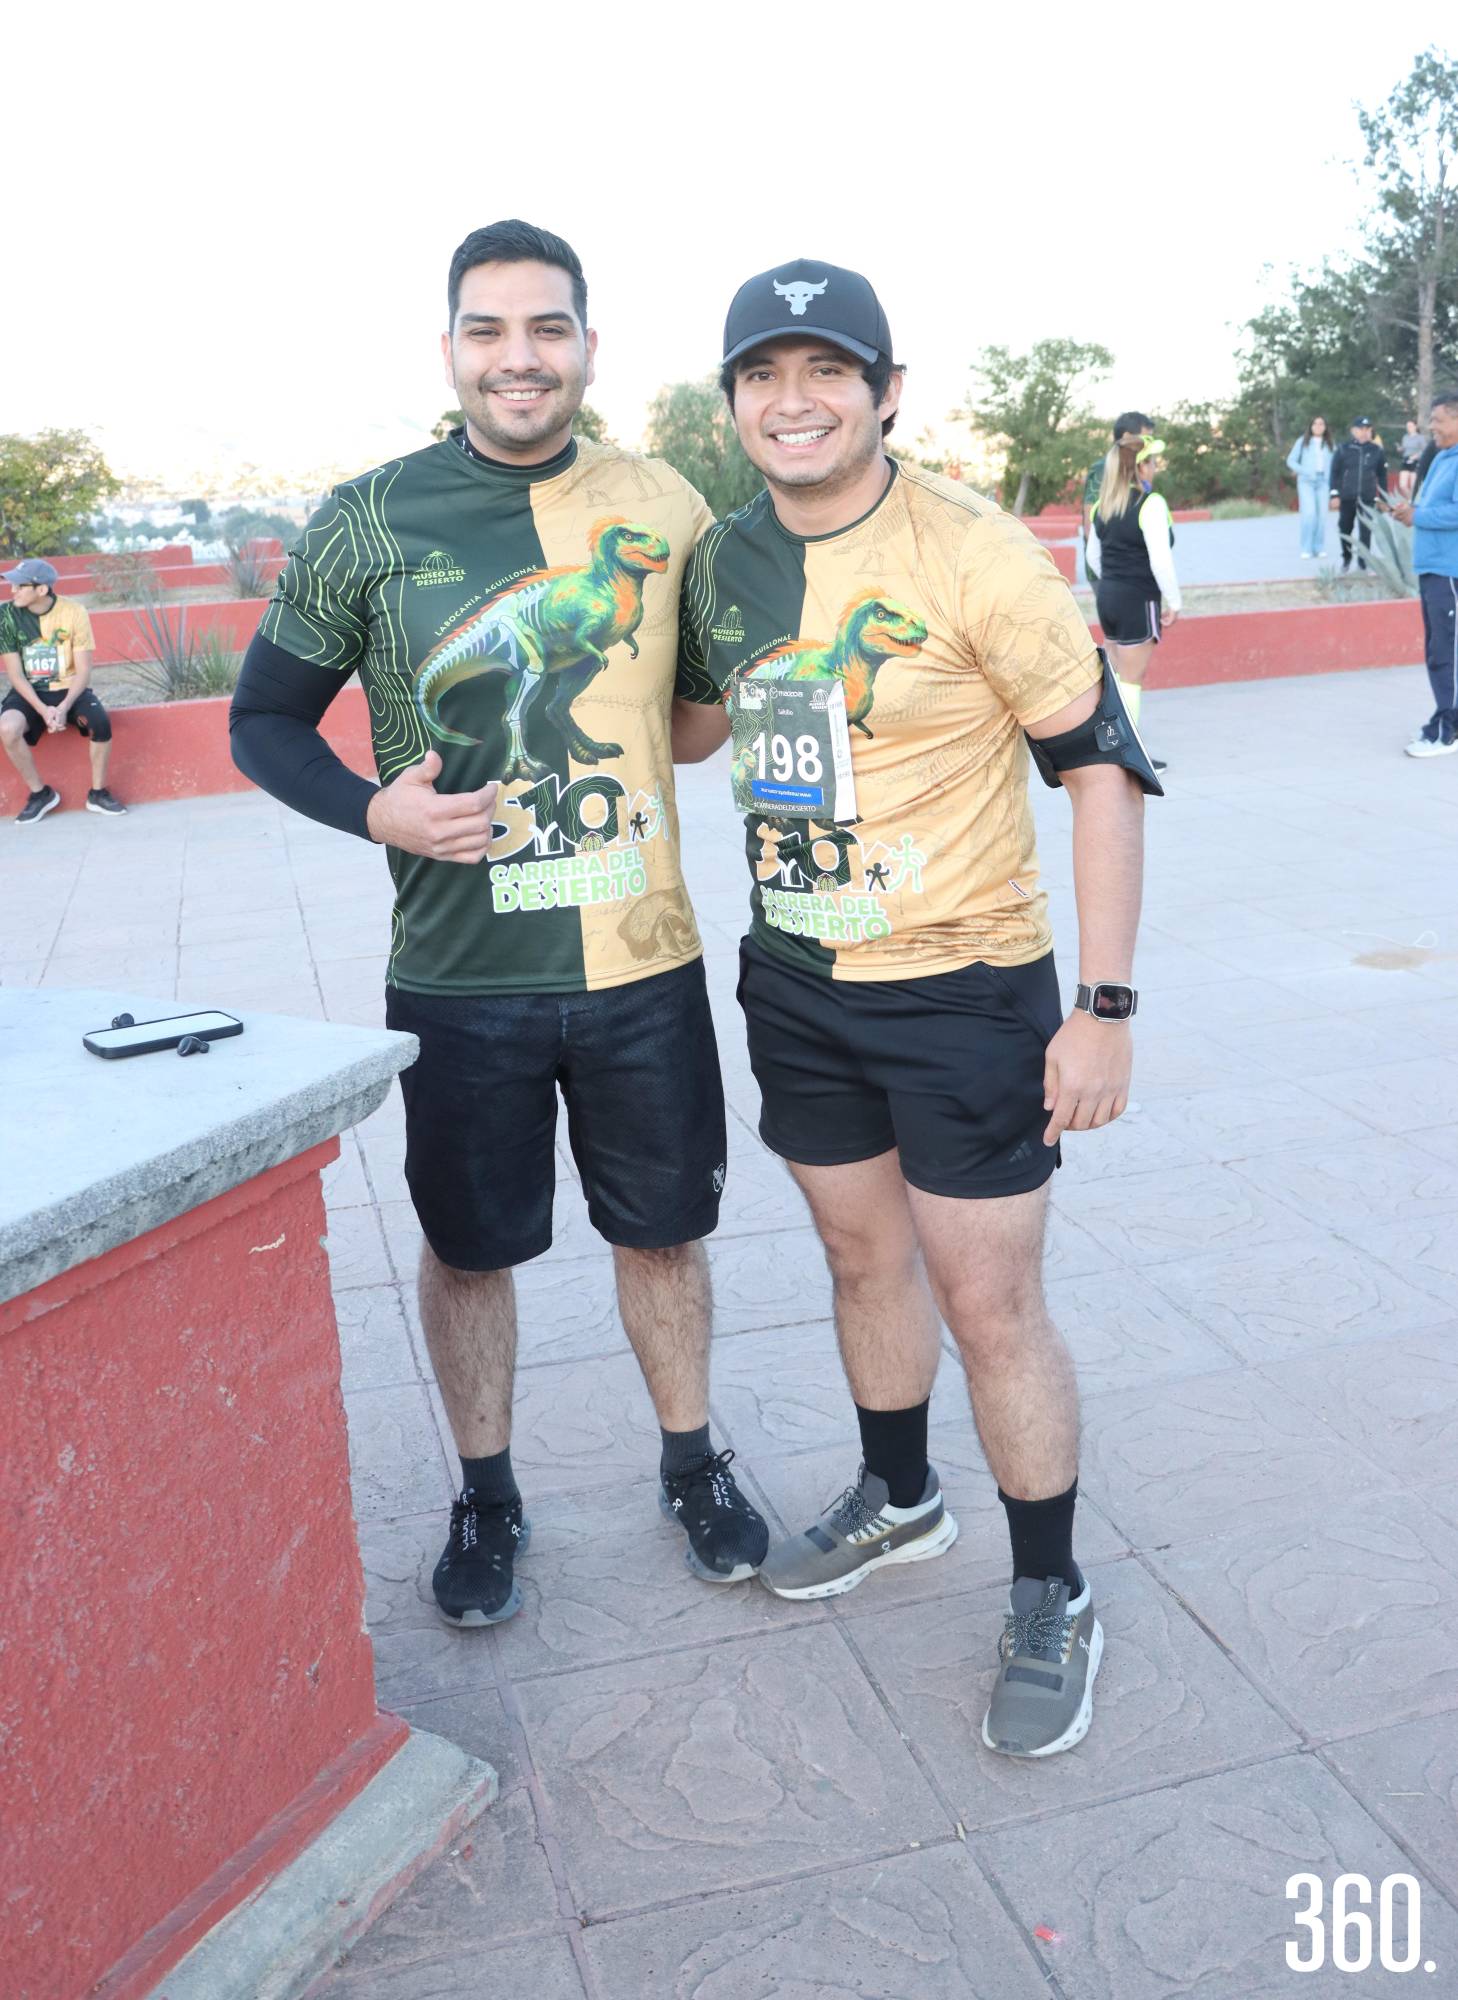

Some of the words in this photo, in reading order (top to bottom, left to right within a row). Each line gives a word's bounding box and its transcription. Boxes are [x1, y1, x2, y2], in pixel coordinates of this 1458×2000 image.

[411, 570, 446, 581] MUSEO
[448, 568, 467, 577] DEL
[416, 575, 464, 587] DESIERTO
[434, 595, 482, 637] LABOCANIA
[485, 564, 538, 594] AGUILLONAE
[711, 627, 734, 637] MUSEO
[712, 634, 743, 643] DESIERTO
[750, 633, 792, 659] AGUILLONAE
[26, 657, 57, 671] 1167
[752, 732, 824, 783] 198
[489, 857, 605, 886] CARRERA
[606, 846, 645, 874] DEL
[492, 867, 647, 914] DESIERTO
[841, 894, 885, 918] DEL
[763, 902, 893, 943] DESIERTO
